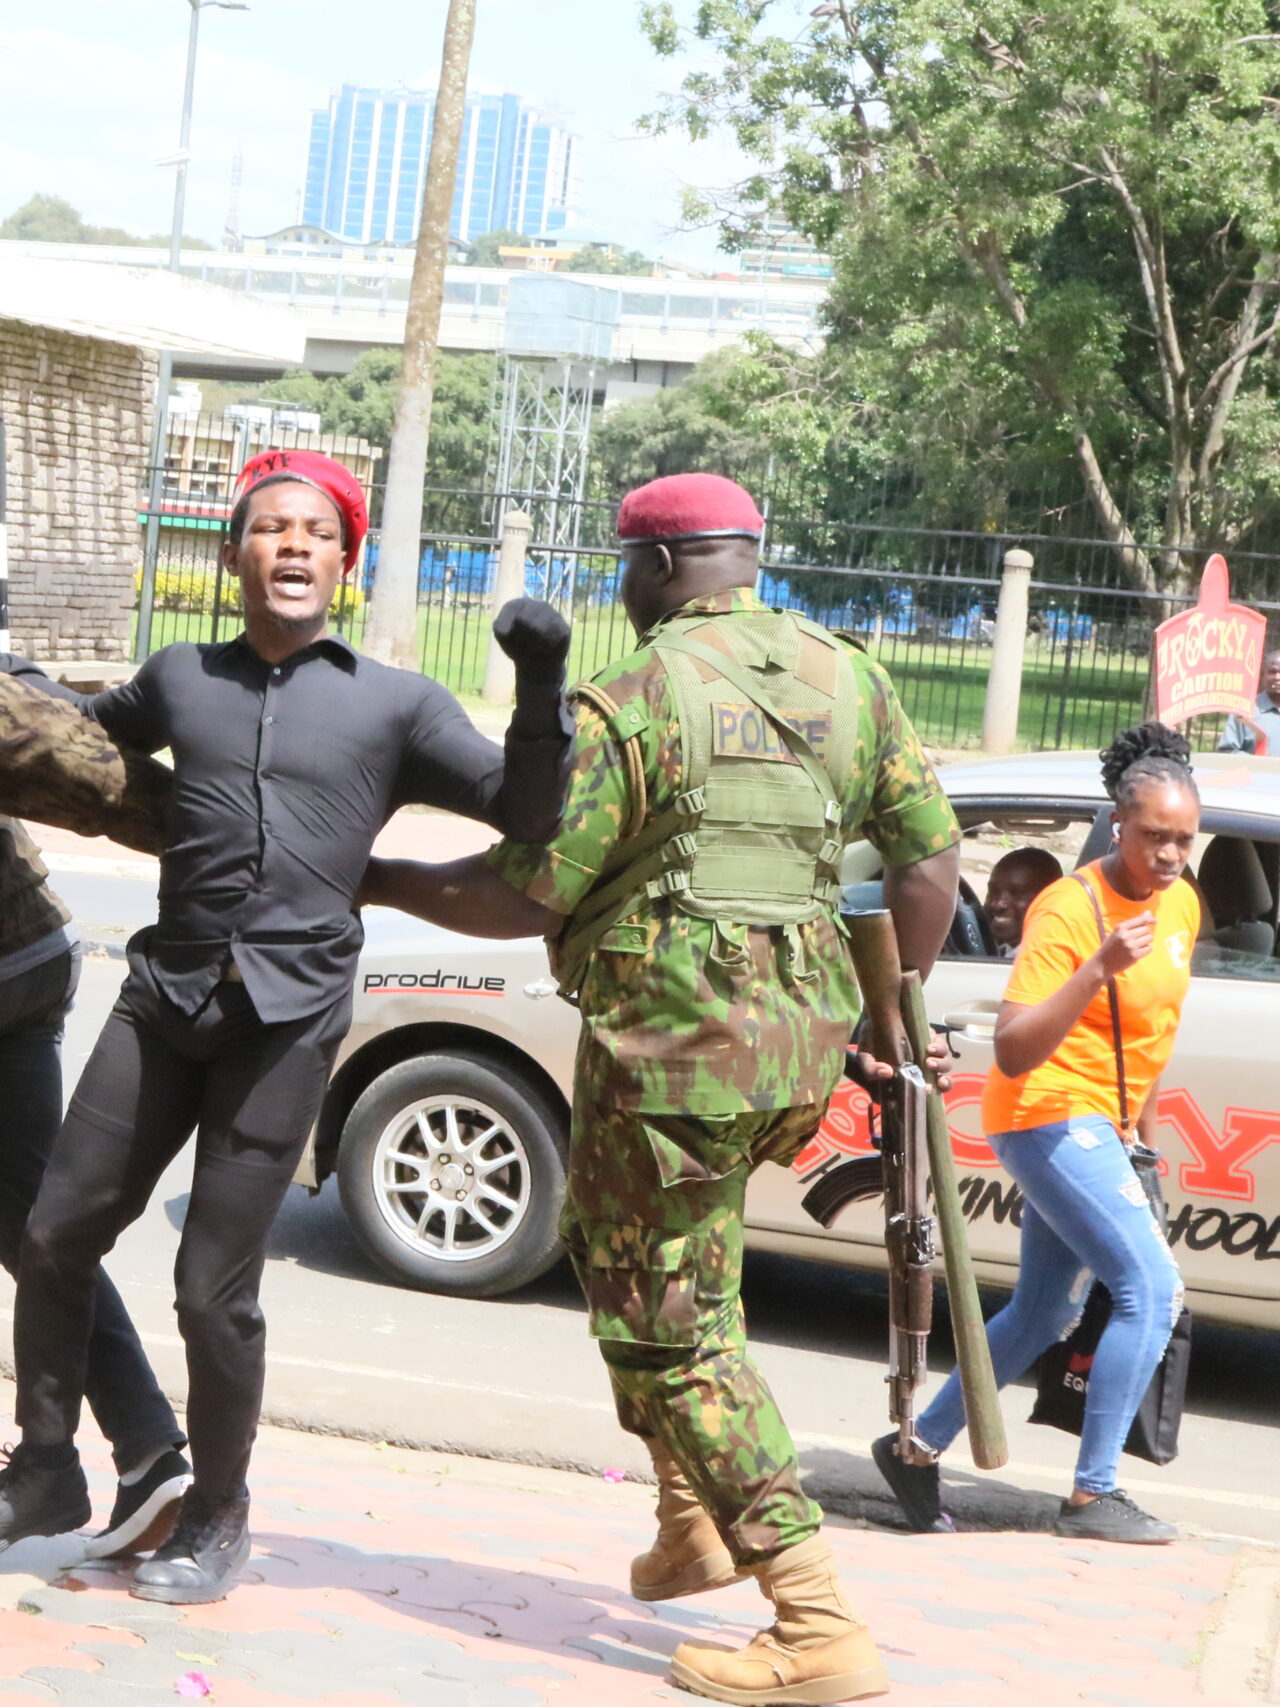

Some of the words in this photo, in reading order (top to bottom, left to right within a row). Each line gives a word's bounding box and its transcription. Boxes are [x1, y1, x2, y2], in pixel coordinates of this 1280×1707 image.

[1168, 612, 1247, 681] ROCKY
[1171, 672, 1244, 702] CAUTION
[363, 969, 506, 993] prodrive
